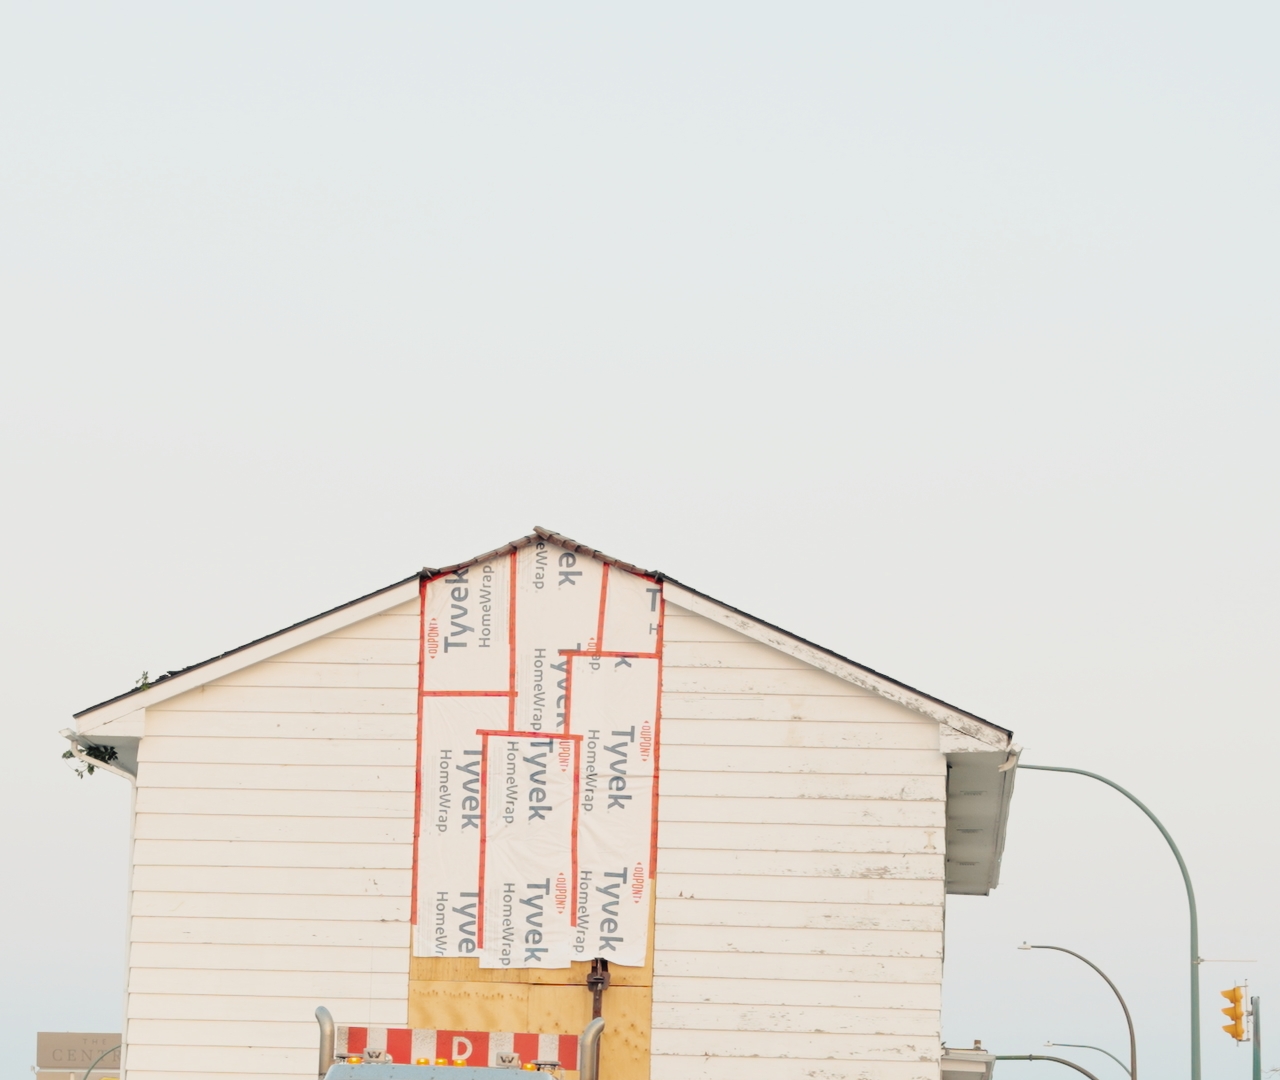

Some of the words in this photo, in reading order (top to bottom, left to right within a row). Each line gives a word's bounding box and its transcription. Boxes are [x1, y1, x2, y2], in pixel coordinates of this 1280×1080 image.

[443, 567, 475, 654] Tyvek
[478, 564, 495, 648] HomeWrap
[529, 648, 547, 731] HomeWrap
[435, 749, 453, 833] HomeWrap
[502, 741, 520, 825] HomeWrap
[522, 737, 554, 821] Tyvek
[581, 729, 600, 812] HomeWrap
[602, 725, 636, 810] Tyvek
[498, 882, 516, 966] HomeWrap
[518, 877, 552, 963] Tyvek
[572, 870, 593, 954] HomeWrap
[594, 866, 628, 952] Tyvek
[451, 1036, 473, 1060] D
